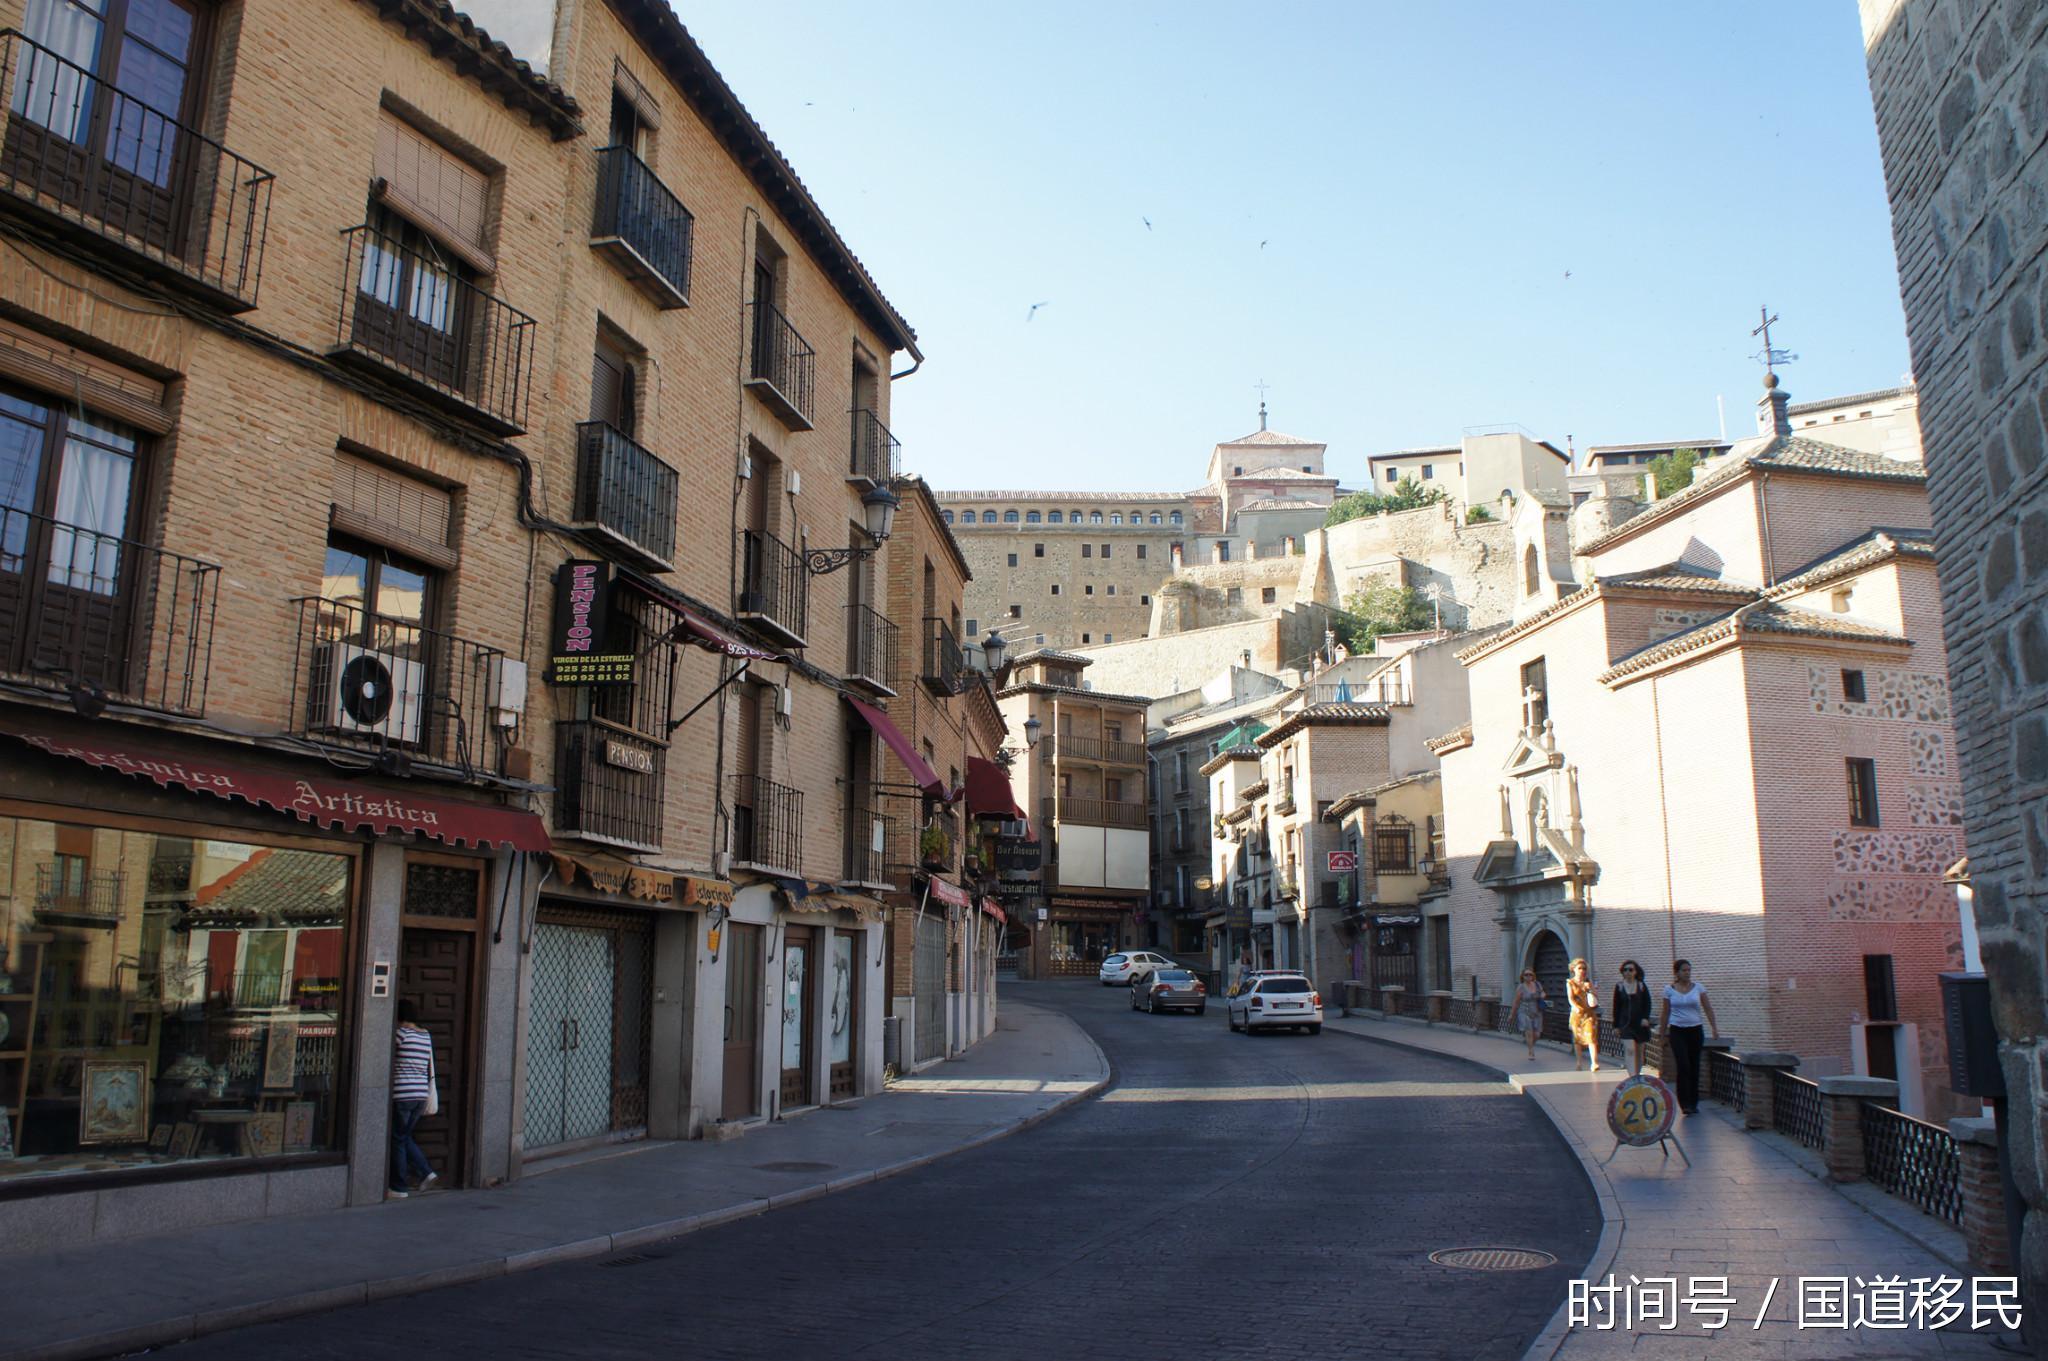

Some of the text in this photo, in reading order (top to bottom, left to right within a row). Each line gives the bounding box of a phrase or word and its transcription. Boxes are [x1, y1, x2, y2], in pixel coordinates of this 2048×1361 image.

[566, 565, 597, 651] PENSION
[727, 643, 748, 656] 925
[552, 654, 635, 664] VIRGEN DE LA ESTRELLA
[556, 665, 579, 673] 925
[598, 664, 612, 672] 21
[555, 674, 578, 682] 650
[614, 673, 630, 681] 02
[292, 780, 439, 825] Artística
[1623, 1096, 1658, 1125] 20
